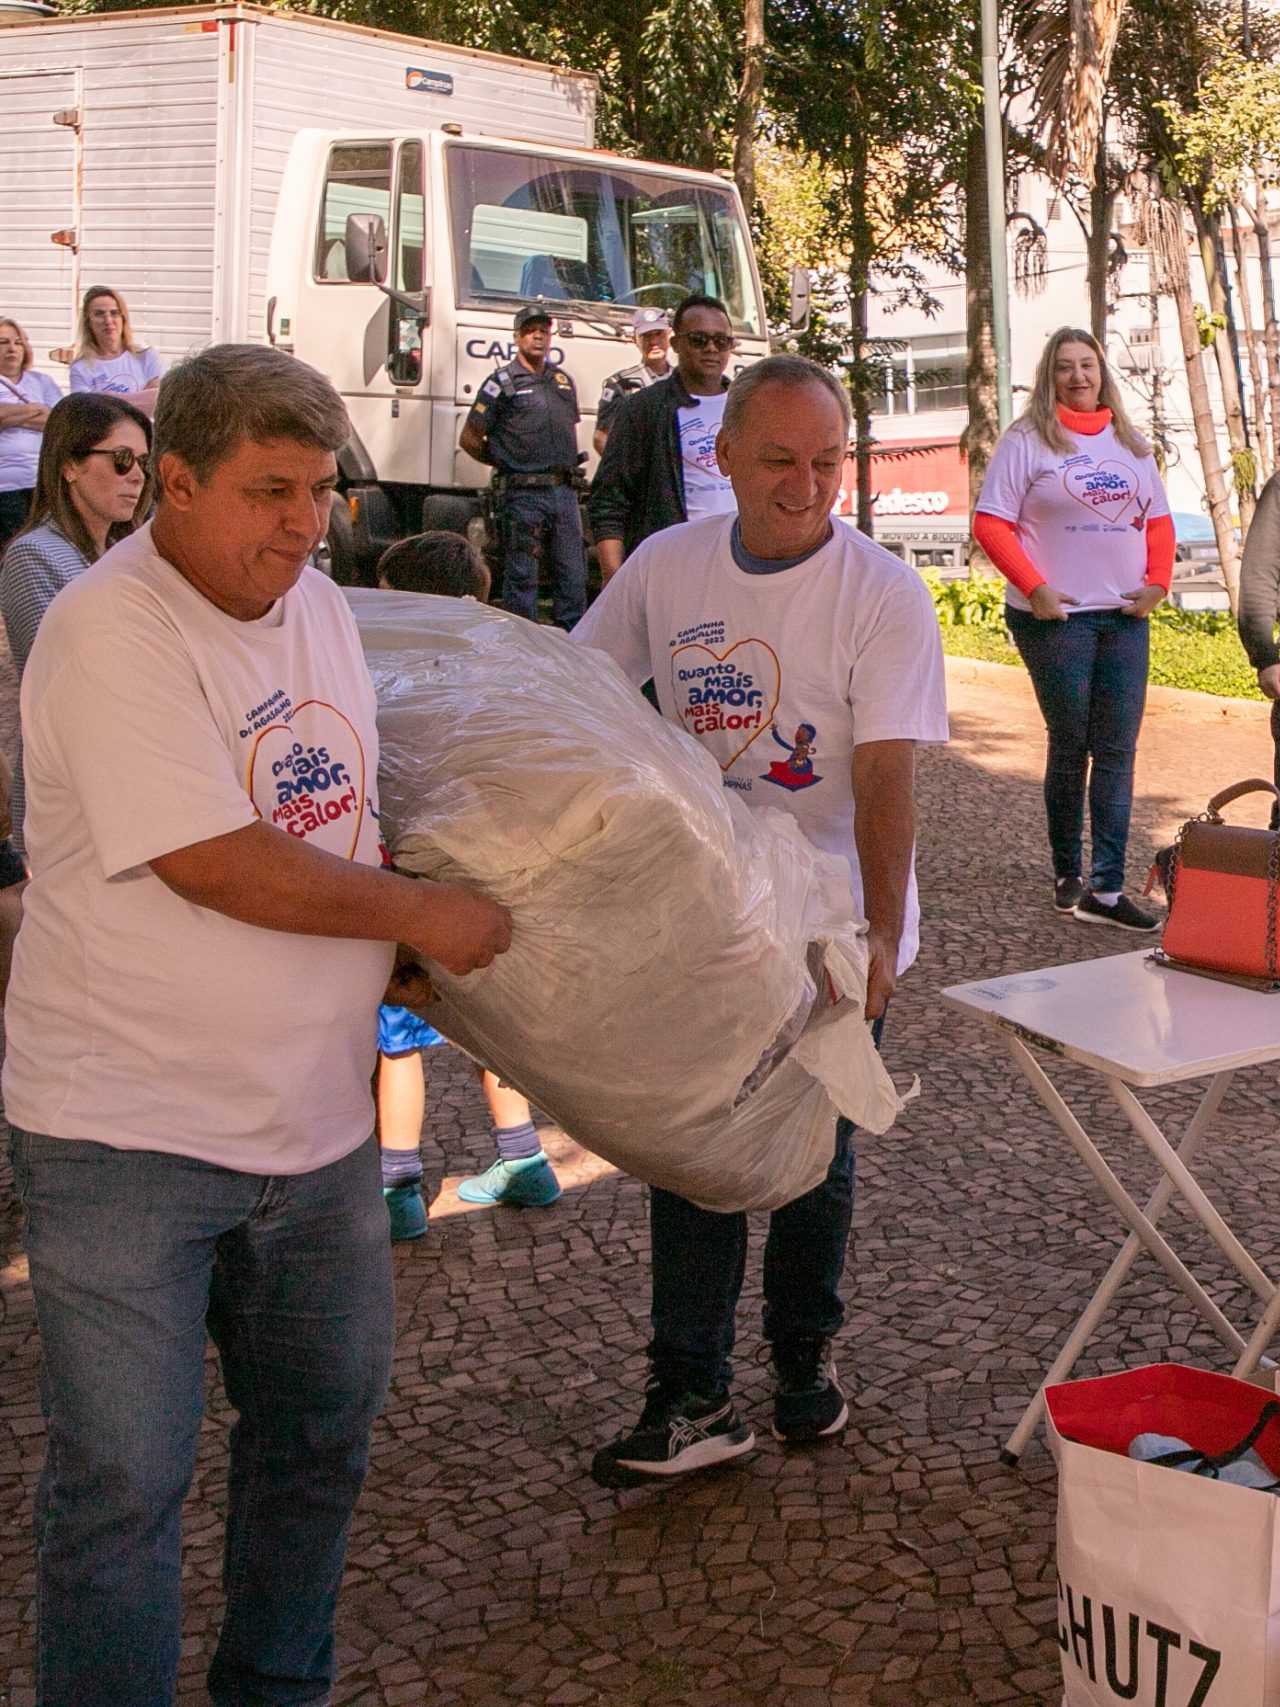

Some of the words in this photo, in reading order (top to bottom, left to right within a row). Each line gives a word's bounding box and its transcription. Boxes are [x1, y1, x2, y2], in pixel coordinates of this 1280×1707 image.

[466, 339, 565, 366] CARO
[851, 487, 949, 515] adesco
[678, 663, 736, 681] Quanto
[688, 687, 763, 708] amor,
[693, 710, 762, 735] calor!
[286, 785, 359, 839] calor!
